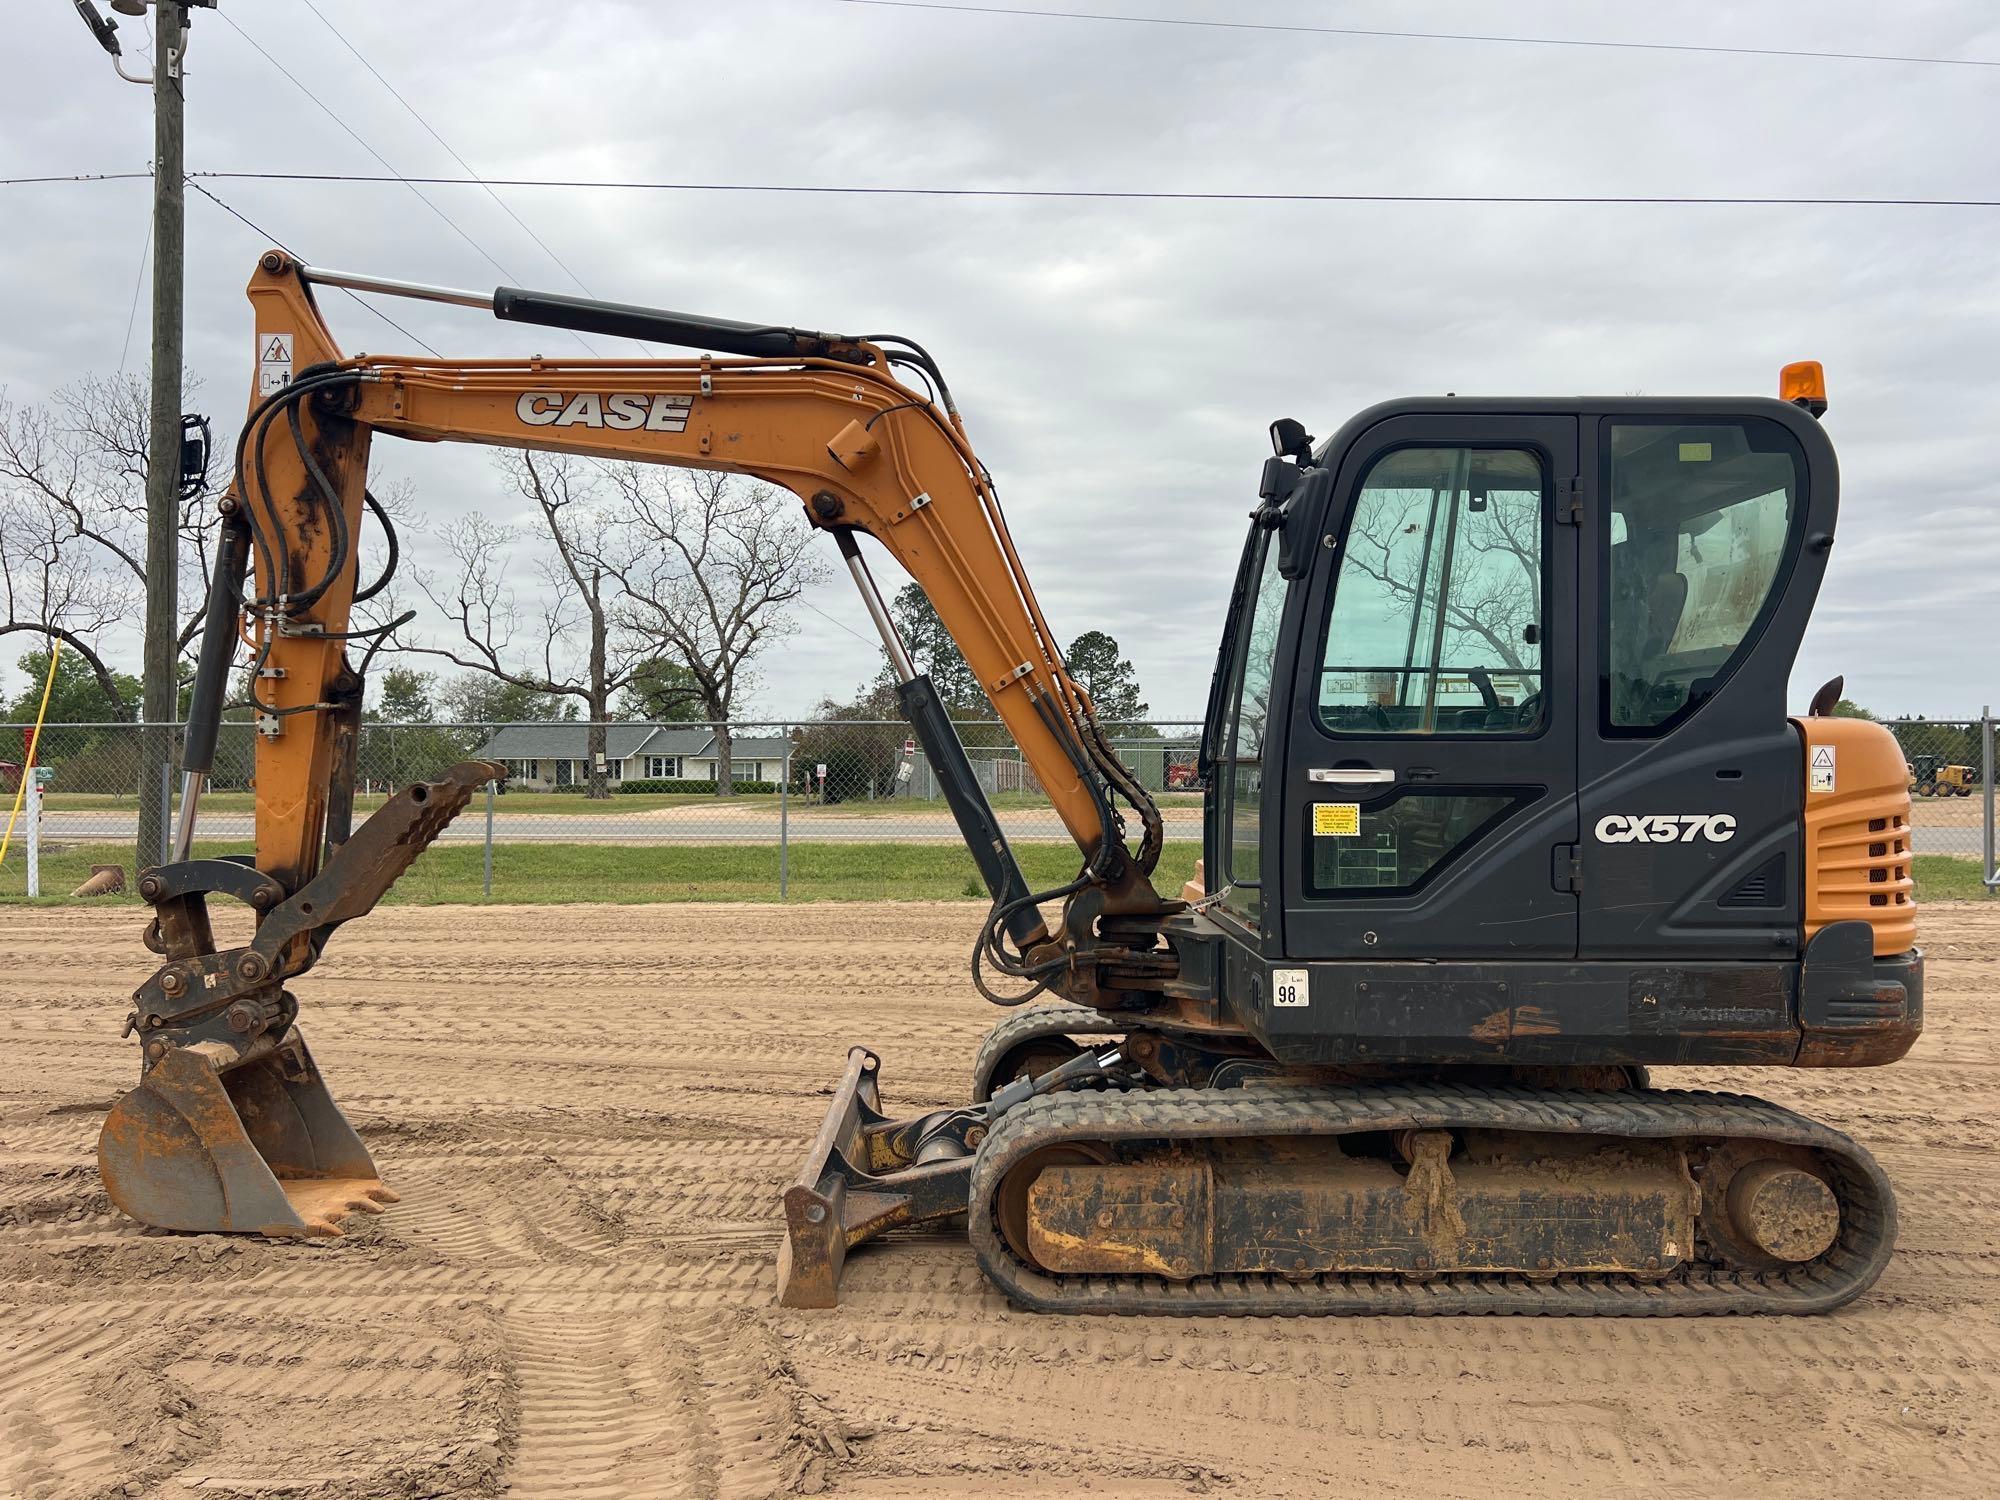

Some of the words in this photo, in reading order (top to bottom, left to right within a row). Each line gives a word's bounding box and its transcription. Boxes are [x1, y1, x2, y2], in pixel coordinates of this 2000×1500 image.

[515, 391, 695, 433] CASE
[1594, 813, 1737, 844] CX57C
[1278, 985, 1296, 1003] 98
